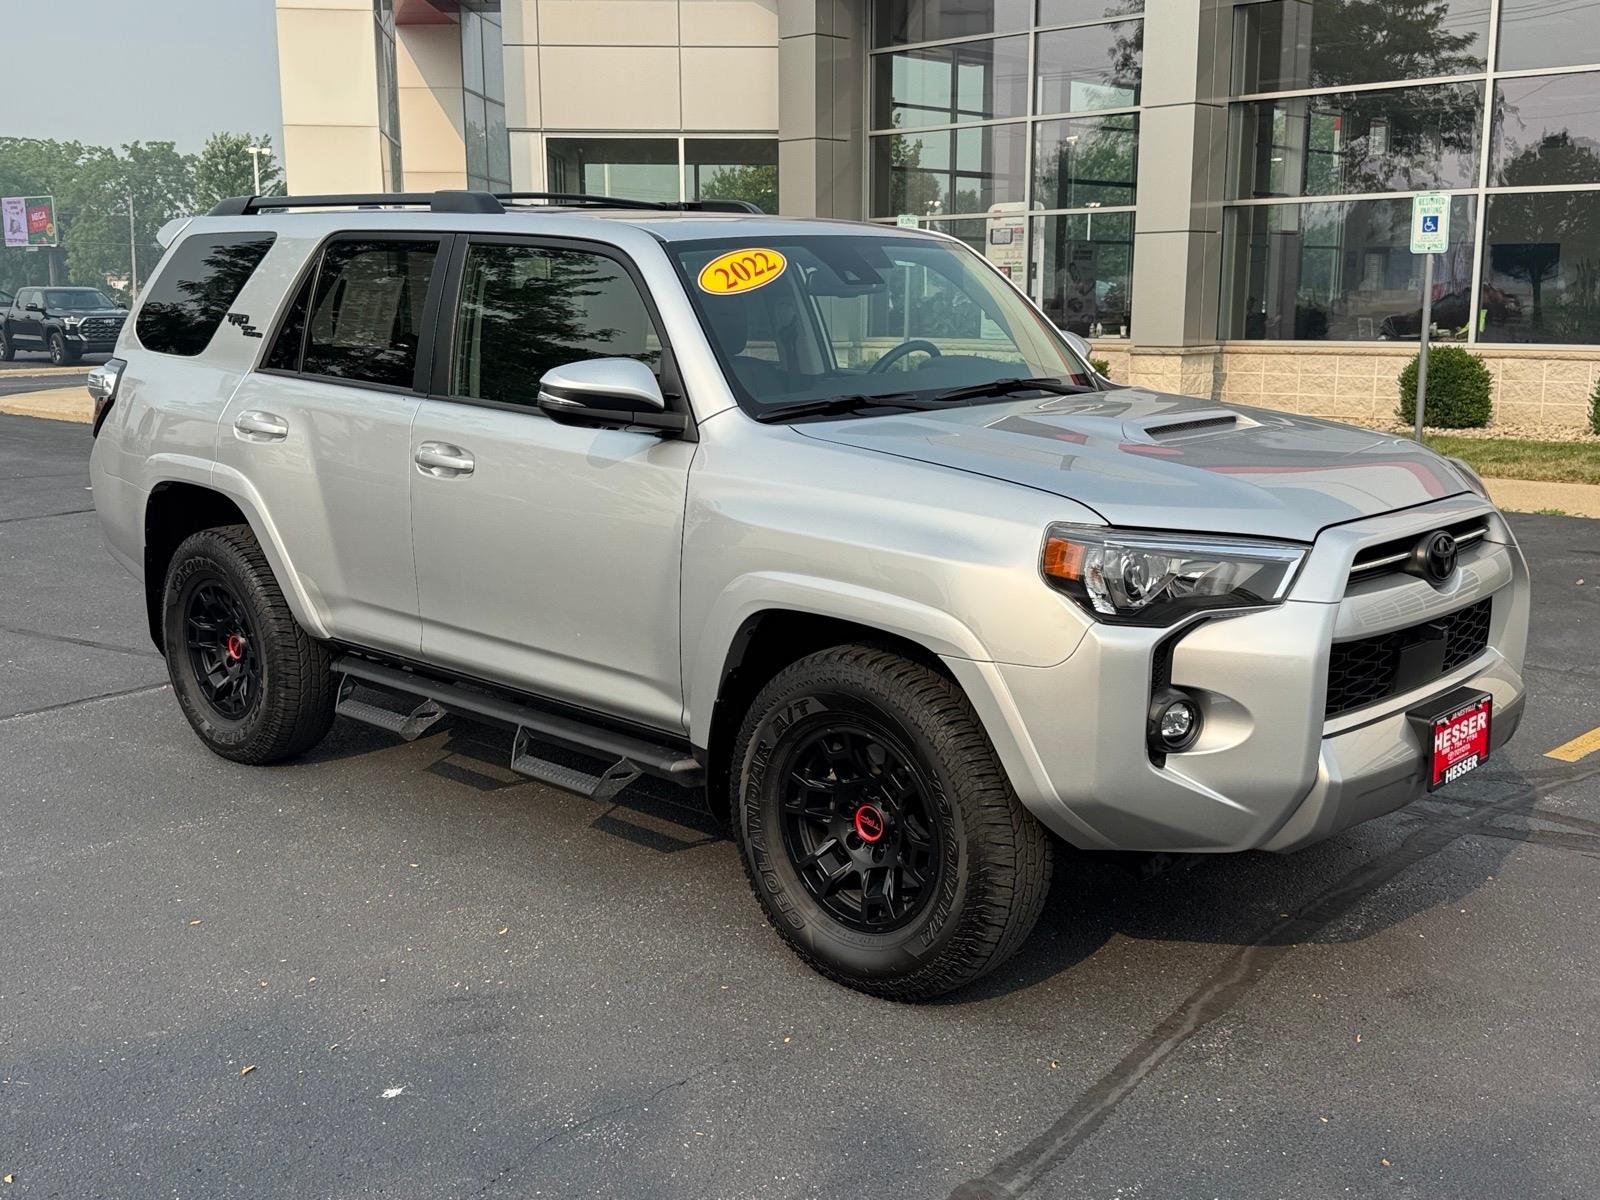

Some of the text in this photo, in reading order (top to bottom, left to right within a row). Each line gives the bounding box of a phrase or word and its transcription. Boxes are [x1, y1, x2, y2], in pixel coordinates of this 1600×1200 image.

[714, 252, 777, 289] 2022
[227, 312, 250, 327] TRD
[1434, 712, 1487, 753] HESSER
[1445, 754, 1478, 784] HESSER
[746, 739, 806, 930] GEOLANDAR
